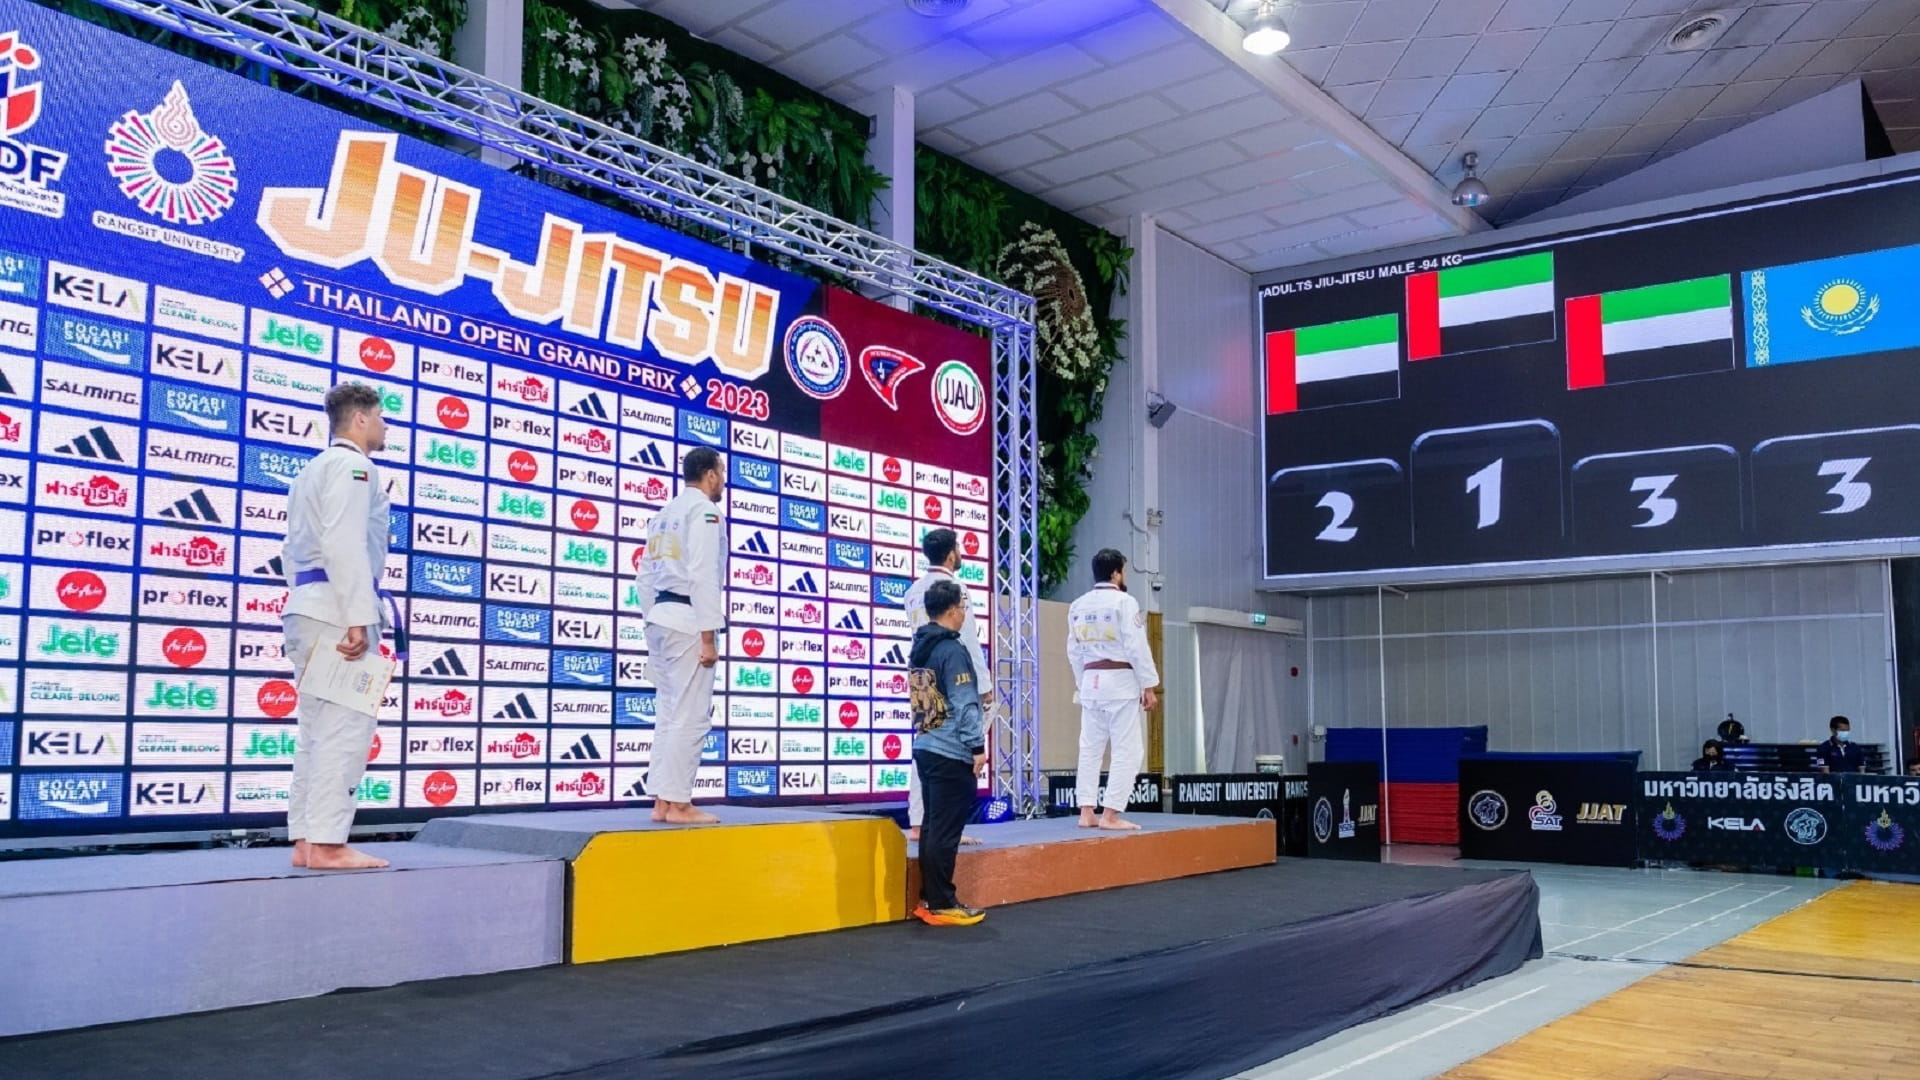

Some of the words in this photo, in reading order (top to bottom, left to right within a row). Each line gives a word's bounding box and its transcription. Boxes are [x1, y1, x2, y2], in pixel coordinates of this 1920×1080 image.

[0, 139, 62, 183] DF
[97, 215, 158, 240] RANGSIT
[162, 229, 243, 260] UNIVERSITY
[256, 130, 781, 381] JU-JITSU
[1264, 280, 1312, 297] ADULTS
[1315, 270, 1375, 289] JIU-JITSU
[1378, 261, 1415, 279] MALE
[1418, 257, 1438, 270] -94
[1441, 254, 1463, 266] KG
[53, 272, 141, 313] KELA
[64, 320, 129, 343] POCARI
[64, 332, 123, 350] SWEAT
[261, 318, 323, 354] Jele
[304, 282, 452, 337] THAILAND
[459, 321, 531, 357] OPEN
[538, 341, 621, 380] GRAND
[627, 364, 677, 394] PRIX
[156, 343, 236, 379] KELA
[421, 360, 485, 385] proflex
[167, 390, 225, 409] POCARI
[706, 378, 770, 422] 2023
[943, 377, 976, 411] JJAU
[167, 400, 221, 416] SWEAT
[251, 408, 324, 440] KELA
[494, 416, 551, 438] proflex
[734, 428, 775, 452] KELA
[260, 452, 306, 470] POCA
[425, 439, 477, 468] Jele
[833, 449, 866, 472] Jele
[260, 463, 302, 477] SWEA
[560, 468, 613, 488] proflex
[916, 470, 949, 486] proflex
[784, 472, 822, 494] KELA
[1465, 457, 1502, 529] 1
[1817, 457, 1872, 514] 3
[498, 491, 545, 519] Jele
[877, 490, 907, 512] Jele
[1630, 473, 1679, 528] 3
[831, 512, 866, 531] KELA
[954, 506, 986, 522] proflex
[1314, 491, 1358, 542] 2
[37, 528, 131, 551] proflex
[417, 523, 477, 547] KELA
[564, 540, 607, 567] Jele
[875, 552, 910, 570] KELA
[425, 561, 471, 575] POCARI
[425, 571, 466, 582] SWEAT
[959, 564, 984, 581] Jele
[491, 573, 546, 596] KELA
[143, 590, 228, 608] proflex
[731, 601, 775, 617] proflex
[40, 624, 120, 657] Jele
[558, 620, 608, 640] KELA
[241, 644, 286, 658] prof
[782, 639, 823, 654] proflex
[619, 662, 646, 680] KE
[736, 666, 772, 687] Jele
[830, 676, 868, 689] proflex
[146, 679, 217, 710] Jele
[786, 703, 820, 723] Jele
[874, 709, 911, 722] proflex
[28, 731, 118, 755] KELA
[410, 736, 474, 754] proflex
[732, 738, 774, 754] KELA
[833, 736, 866, 757] Jele
[39, 779, 108, 791] POCARI
[484, 778, 542, 796] proflex
[783, 771, 822, 788] KELA
[877, 769, 908, 788] Jele
[1285, 780, 1308, 798] RANGS
[1644, 776, 1834, 800] มหาวิทยาลัยรังสิต
[39, 789, 100, 801] SWEAT
[136, 782, 216, 804] KELA
[1179, 782, 1222, 803] RANGSIT
[1225, 781, 1279, 800] UNIVERSITY
[1855, 781, 1920, 804] มหาวิ
[1358, 804, 1377, 822] JJAT
[1536, 816, 1562, 827] SAT
[1576, 802, 1627, 821] JJAT
[1707, 816, 1766, 831] KELA
